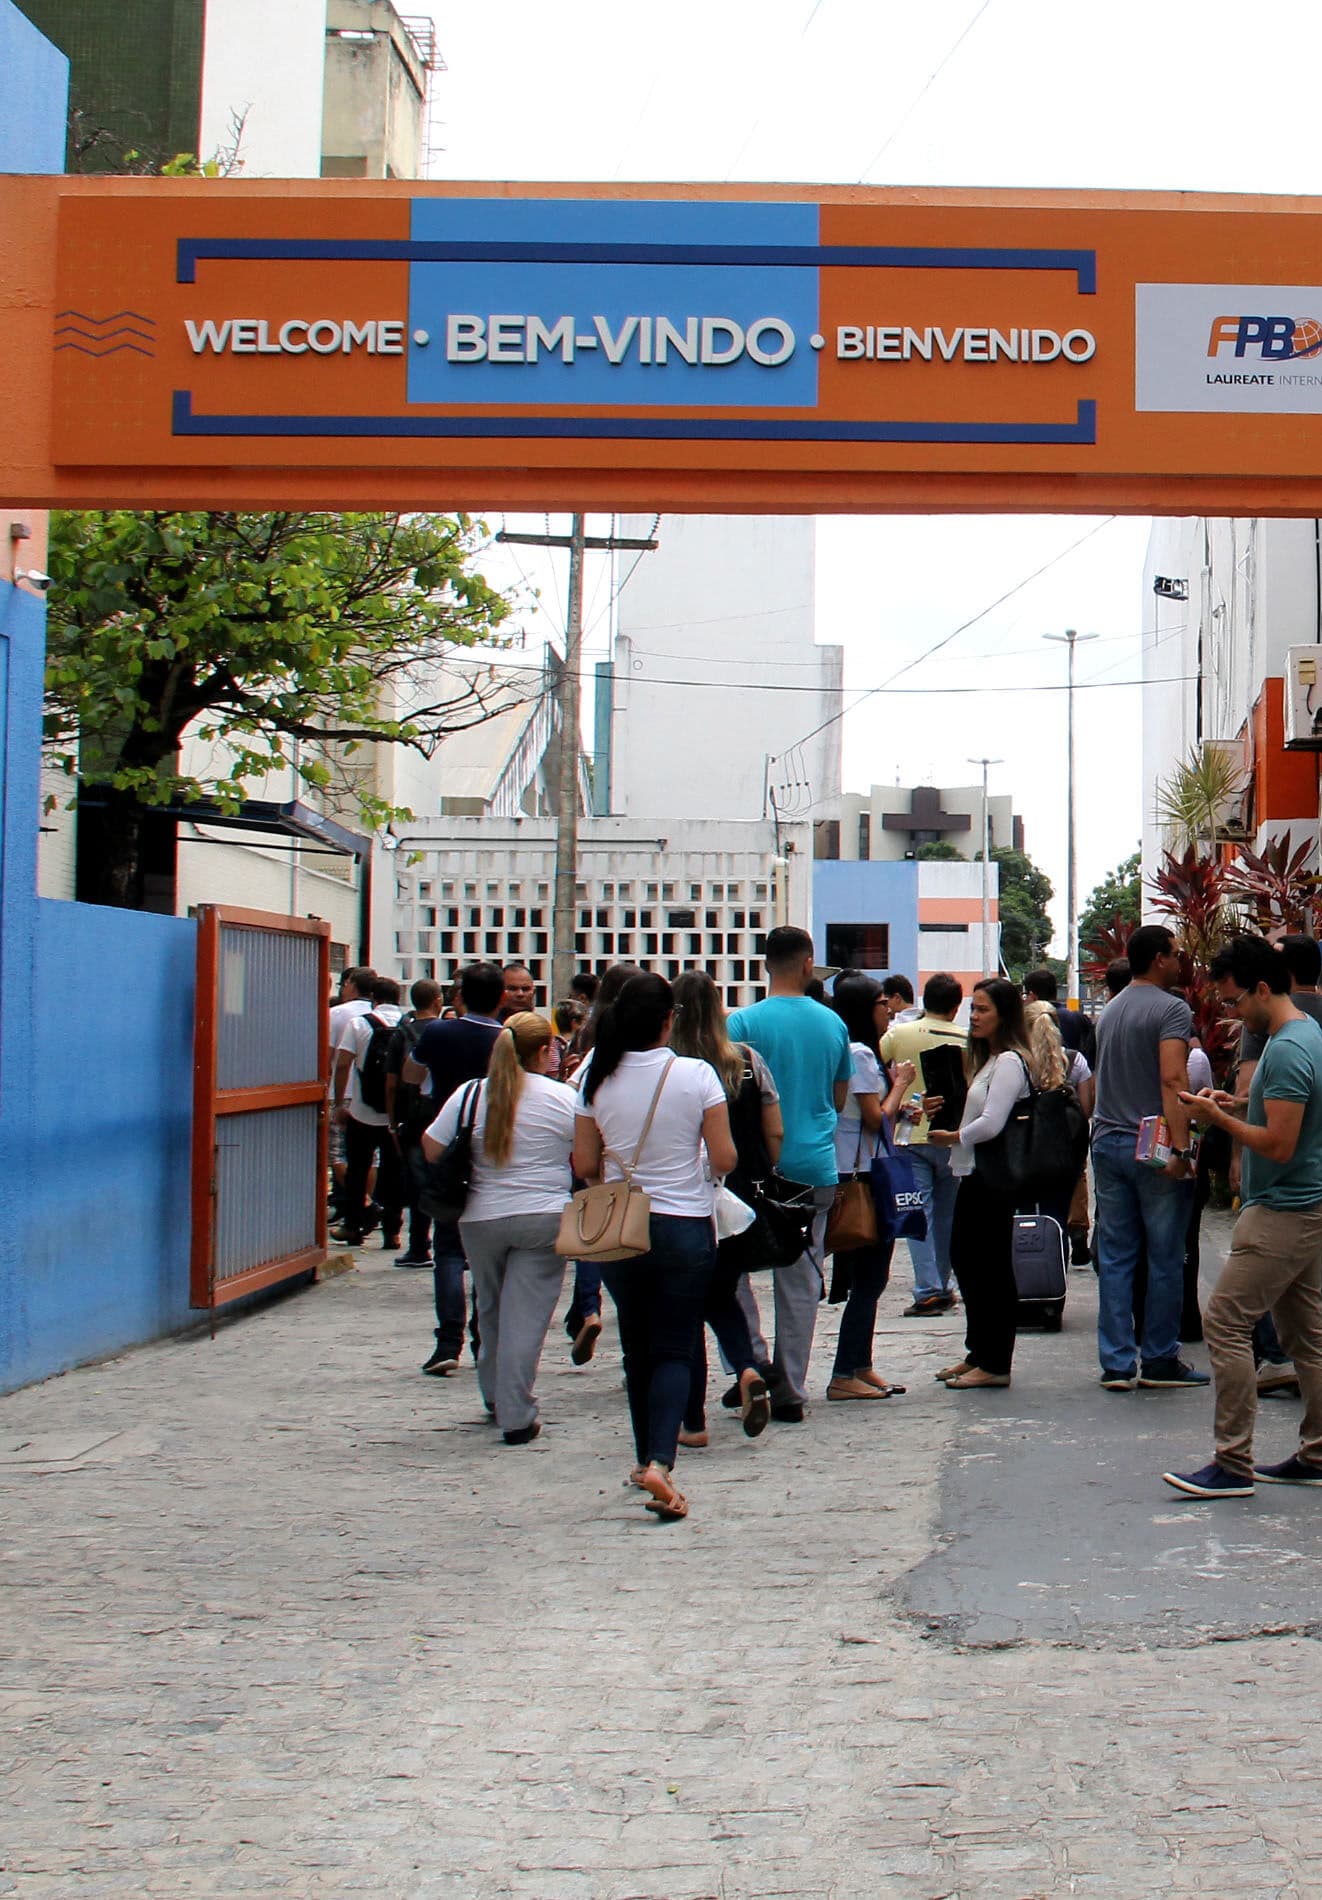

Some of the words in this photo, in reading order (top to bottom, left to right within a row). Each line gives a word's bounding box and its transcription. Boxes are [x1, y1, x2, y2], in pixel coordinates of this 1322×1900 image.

[184, 319, 405, 355] WELCOME
[445, 314, 796, 366] BEM-VINDO
[836, 325, 1097, 363] BIENVENIDO
[1206, 315, 1297, 359] FPB
[1206, 374, 1275, 386] LAUREATE
[895, 1191, 925, 1206] EPSO
